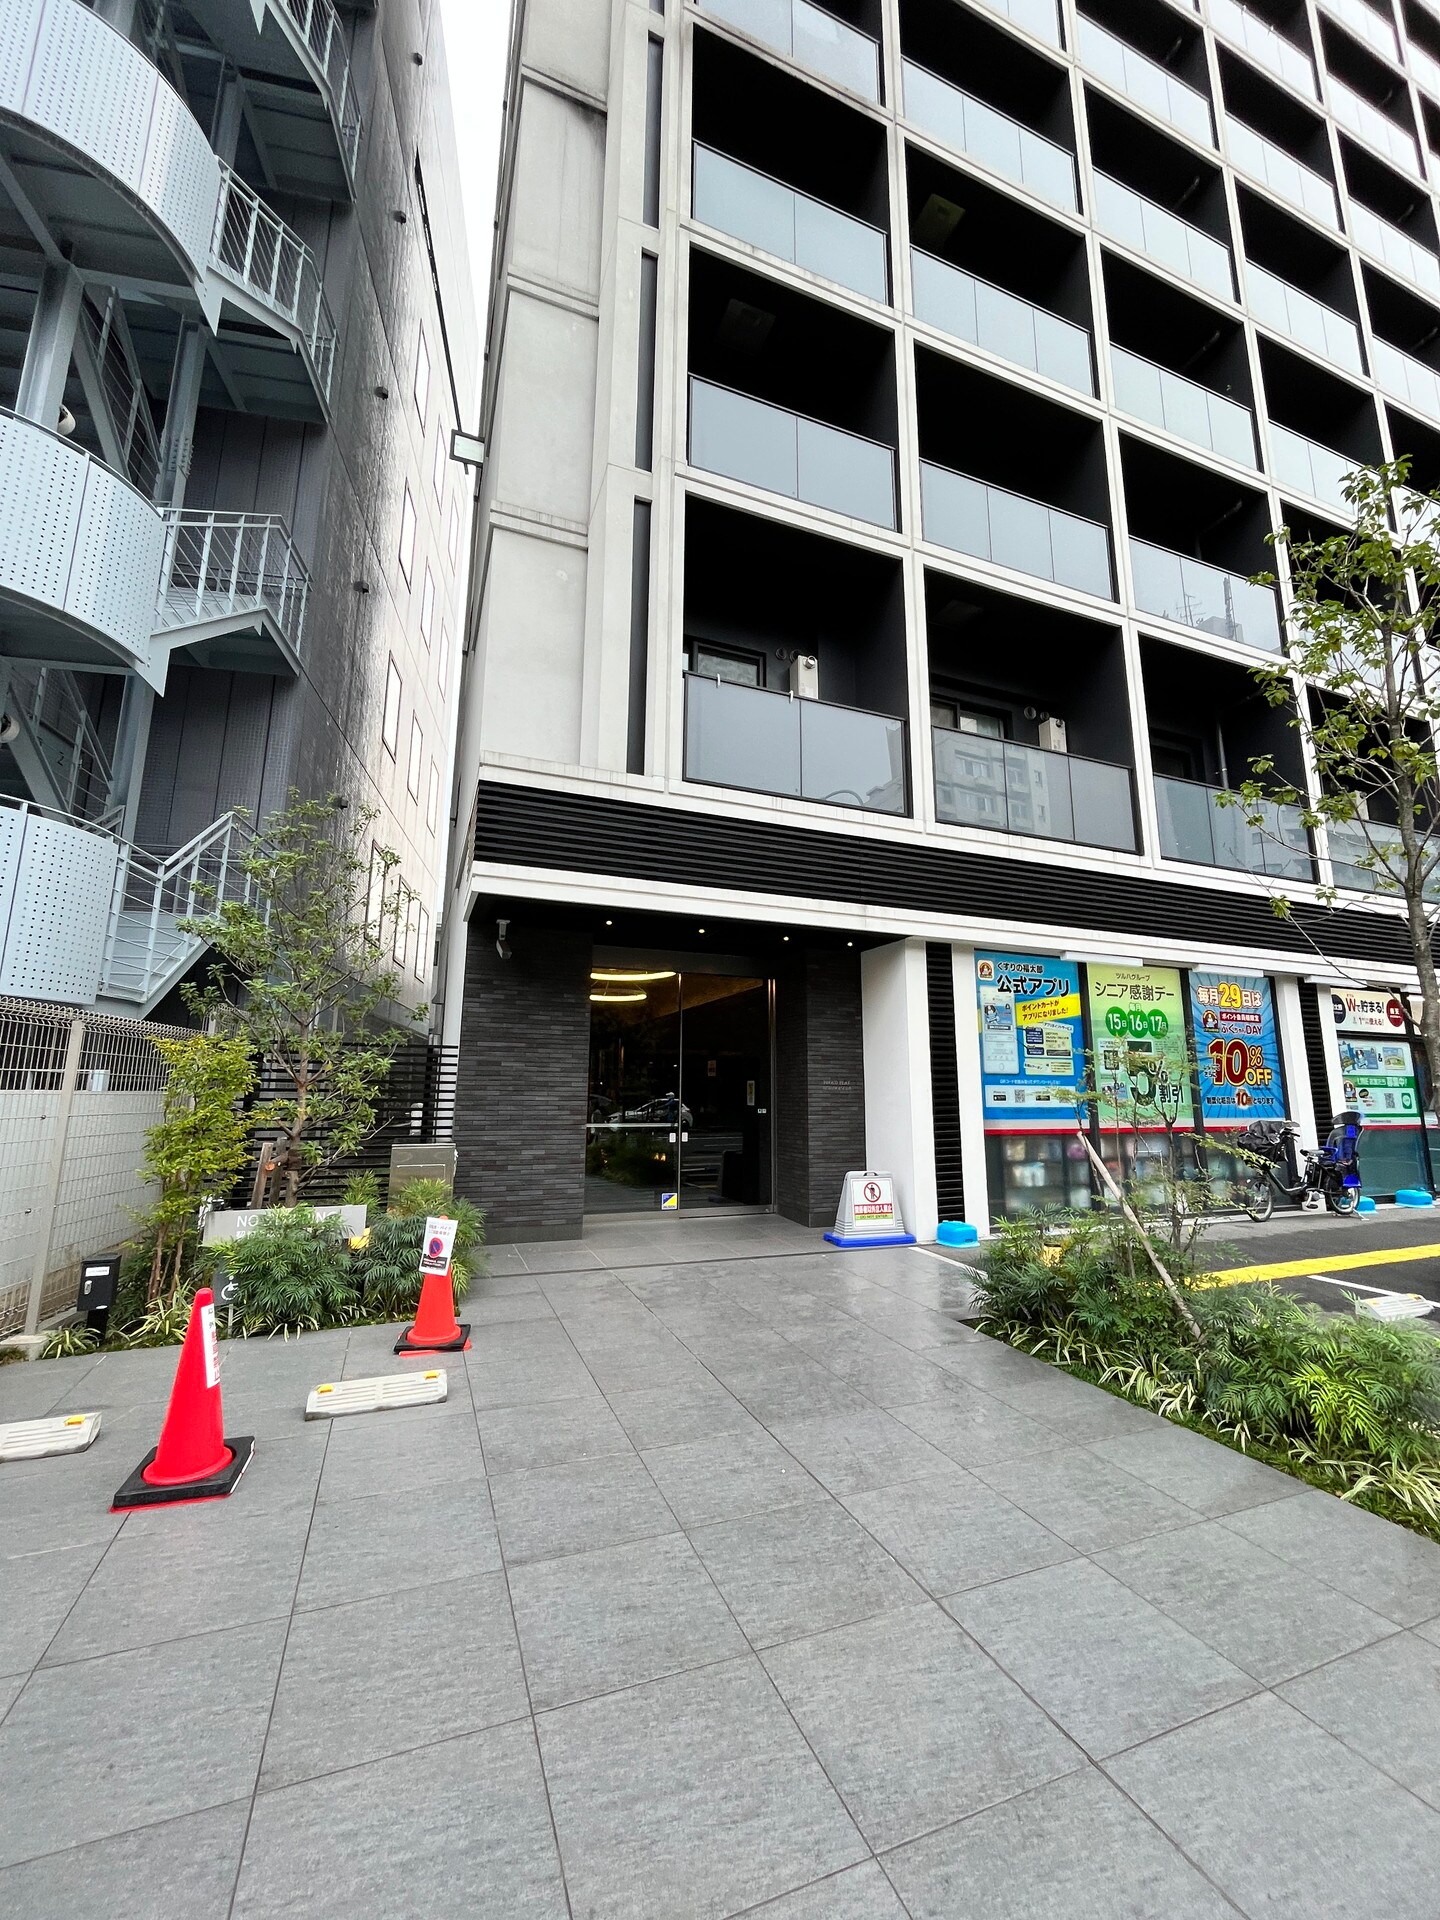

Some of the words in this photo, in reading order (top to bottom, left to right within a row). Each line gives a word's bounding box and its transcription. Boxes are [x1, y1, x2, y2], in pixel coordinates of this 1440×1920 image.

[997, 962, 1044, 974] くすりの福太郎
[1115, 973, 1151, 982] ツルハグループ
[996, 974, 1069, 998] 公式アプリ
[1094, 981, 1175, 1002] シニア感謝デー
[1197, 982, 1263, 1010] 毎月29日は
[1021, 1000, 1060, 1012] ポイントカードが
[1022, 1007, 1069, 1021] アプリになりました!
[1107, 1012, 1128, 1031] 15日
[1129, 1014, 1149, 1032] 16日
[1149, 1015, 1167, 1032] 17日
[1207, 1038, 1264, 1087] 10%
[1244, 1067, 1272, 1086] OFF
[236, 1214, 259, 1228] NO
